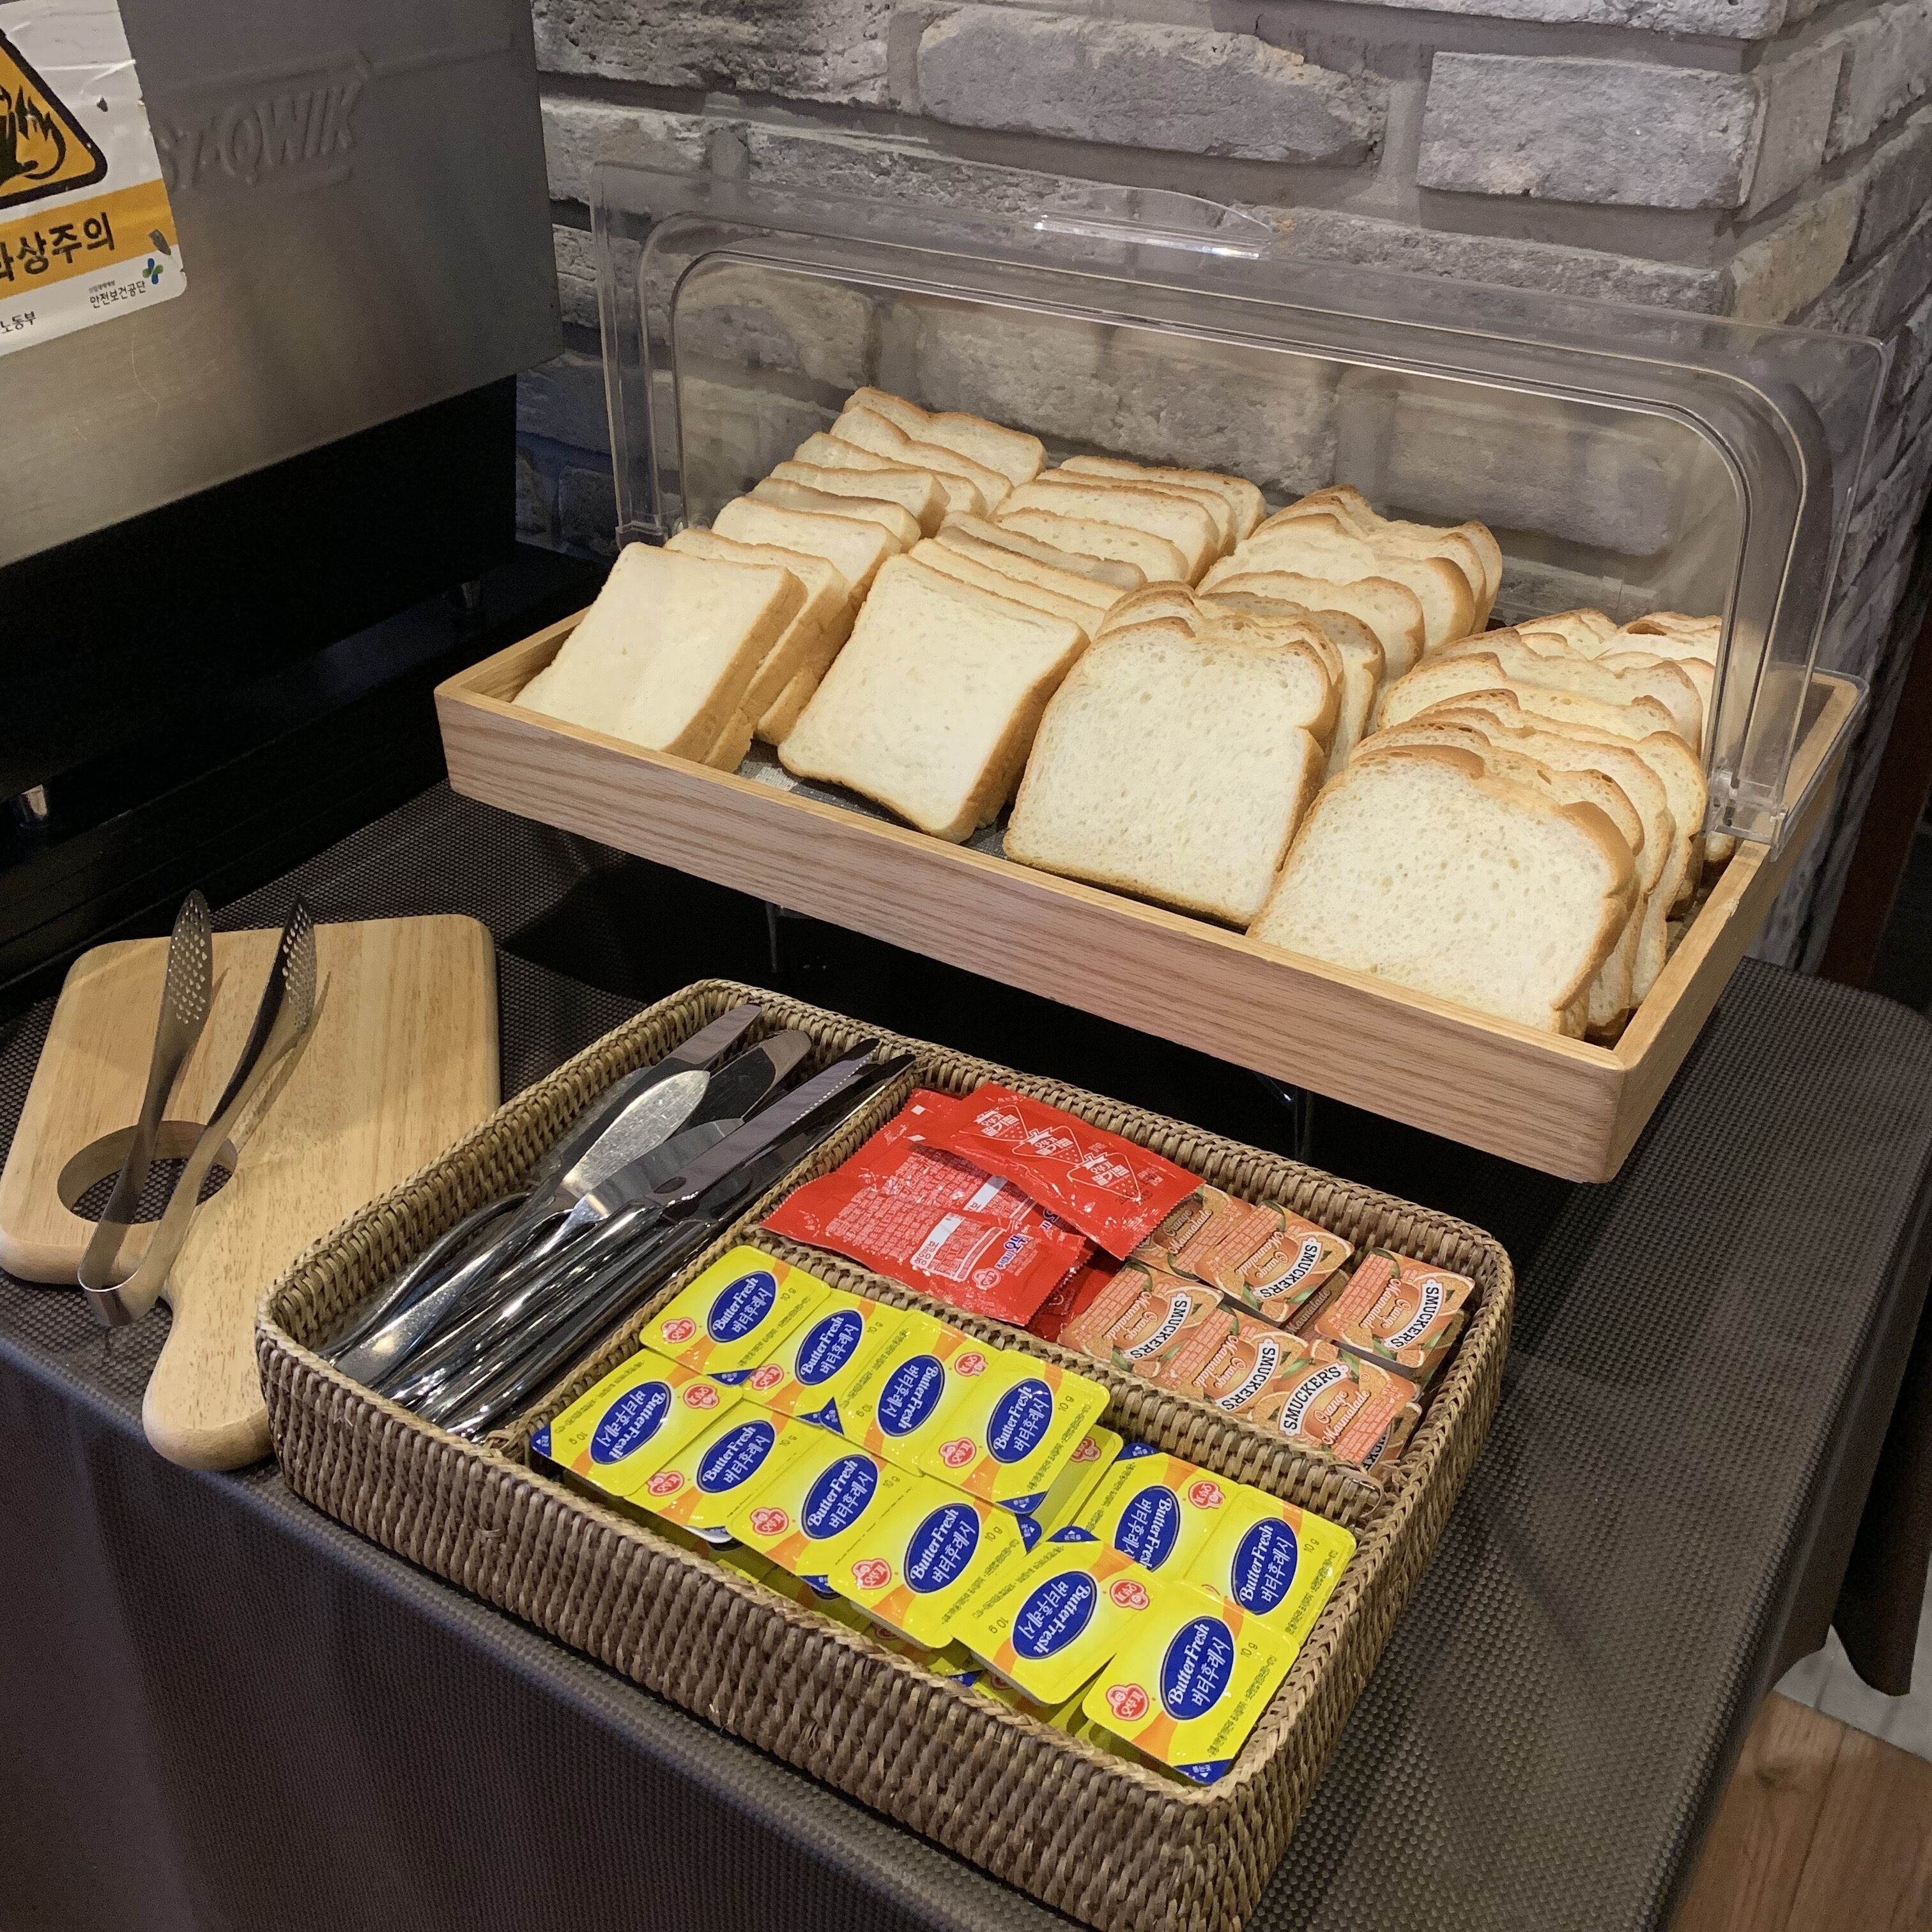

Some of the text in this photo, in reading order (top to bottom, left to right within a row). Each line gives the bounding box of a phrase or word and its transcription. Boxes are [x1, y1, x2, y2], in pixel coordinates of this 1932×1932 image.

[89, 280, 146, 309] 안전보건공단
[1162, 1209, 1193, 1238] Orange
[1168, 1208, 1213, 1255] Marmalade
[1234, 1230, 1285, 1276] Marmalade
[1255, 1251, 1289, 1278] Orange
[1262, 1244, 1318, 1298] SMUCKER'S
[732, 1287, 772, 1333] 버터후레시
[781, 1293, 790, 1301] 10
[1360, 1278, 1402, 1329] Marmalade
[1102, 1291, 1153, 1340] Marmalade
[1124, 1311, 1158, 1340] Orange
[1380, 1298, 1411, 1329] Orange
[1390, 1287, 1439, 1347] SMUCKER'S
[671, 1323, 692, 1340] 오뚜기
[1130, 1300, 1188, 1359] SMUCKER'S
[820, 1324, 859, 1374] 버터후레시
[960, 1355, 977, 1372] 오뚜기
[1192, 1335, 1239, 1388] Marmalade
[760, 1368, 779, 1386] 오뚜기
[1214, 1356, 1246, 1388] Orange
[1222, 1347, 1276, 1410] SMUCKER'S
[689, 1388, 709, 1406] 오뚜기
[881, 1364, 919, 1417] 버터후레시
[1284, 1366, 1341, 1430] SMUCKER'S
[595, 1390, 647, 1447] 버터후레시
[862, 1405, 873, 1413] 10
[1058, 1402, 1069, 1412] 10
[1314, 1390, 1348, 1424] Orange
[1322, 1390, 1371, 1445] Marmalade
[577, 1431, 588, 1441] 10
[1014, 1397, 1050, 1452] 버터후레시
[723, 1435, 771, 1483] 버터후레시
[951, 1443, 972, 1463] 오뚜기
[658, 1475, 680, 1493] 오뚜기
[829, 1471, 874, 1528] 버터후레시
[883, 1480, 894, 1489] 10
[1195, 1483, 1212, 1503] 오뚜기
[762, 1514, 785, 1531] 오뚜기
[985, 1532, 996, 1542] 10
[931, 1521, 976, 1583] 버터후레시
[1303, 1543, 1314, 1553] 10
[864, 1564, 887, 1584] 오뚜기
[1261, 1536, 1294, 1602] 버터후레시
[1114, 1583, 1138, 1602] 오뚜기
[997, 1617, 1009, 1629] 10
[1017, 1581, 1070, 1639] 버터후레시
[1240, 1648, 1253, 1659] 10
[1192, 1637, 1231, 1706] 버터후레시
[1121, 1692, 1145, 1717] 오뚜기
